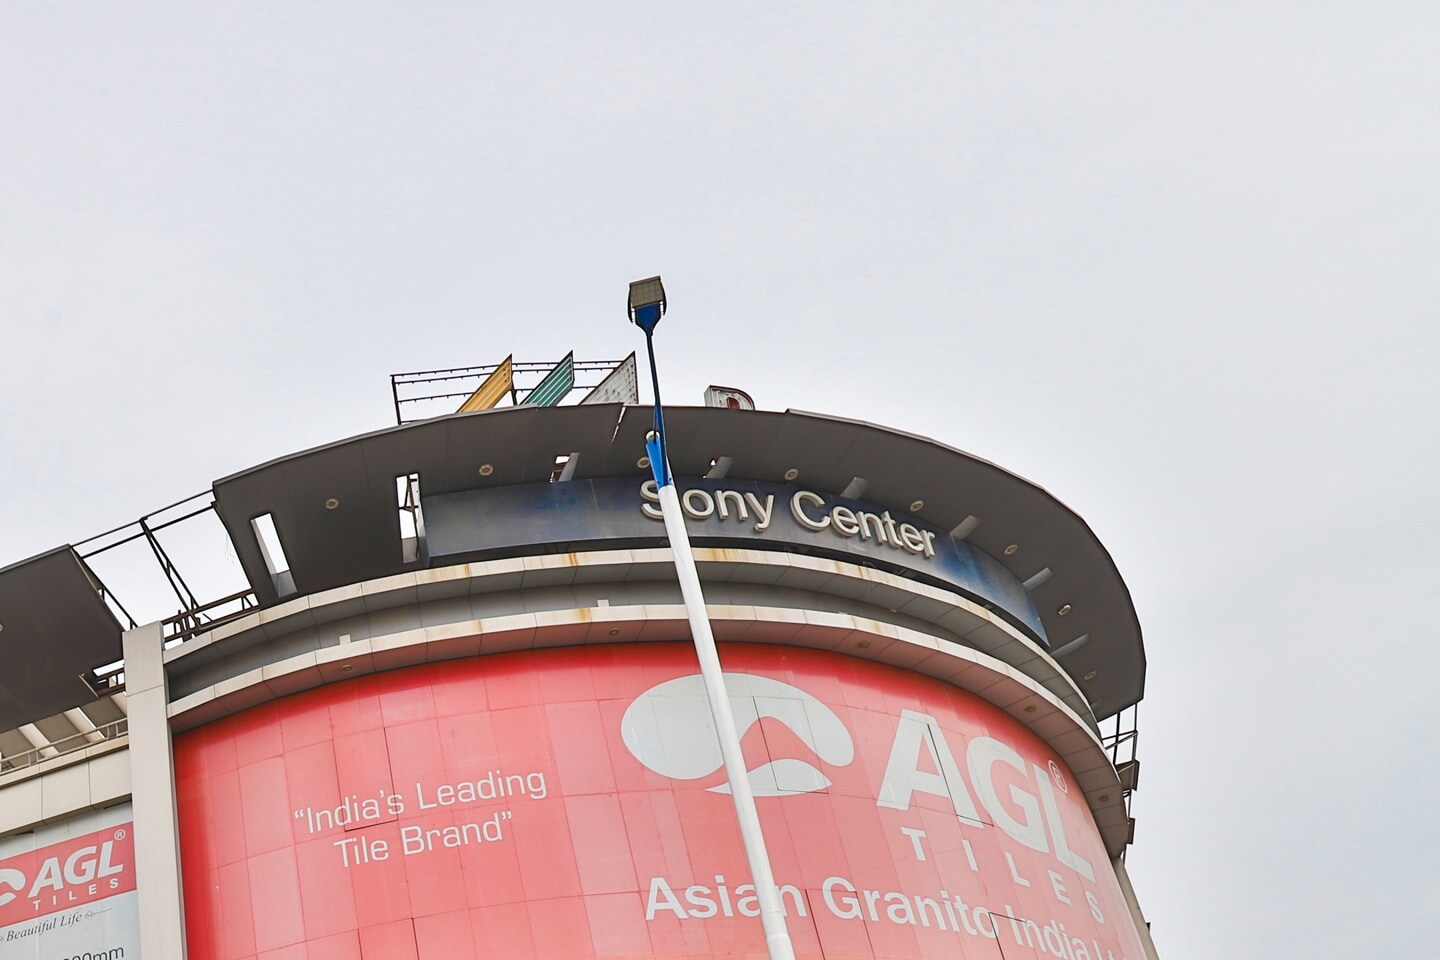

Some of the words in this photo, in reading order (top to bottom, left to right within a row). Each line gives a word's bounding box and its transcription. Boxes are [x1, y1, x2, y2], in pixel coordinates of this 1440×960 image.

[639, 479, 775, 532] Sony
[791, 490, 936, 560] Center
[416, 770, 548, 810] Leading
[876, 708, 1096, 883] AGL
[28, 840, 124, 899] AGL
[333, 836, 389, 867] Tile
[901, 826, 1105, 924] TILES
[33, 879, 119, 911] TILES
[645, 875, 807, 921] Asian
[821, 876, 1000, 940] Granito
[6, 916, 57, 942] Beautiful
[59, 911, 83, 927] Life
